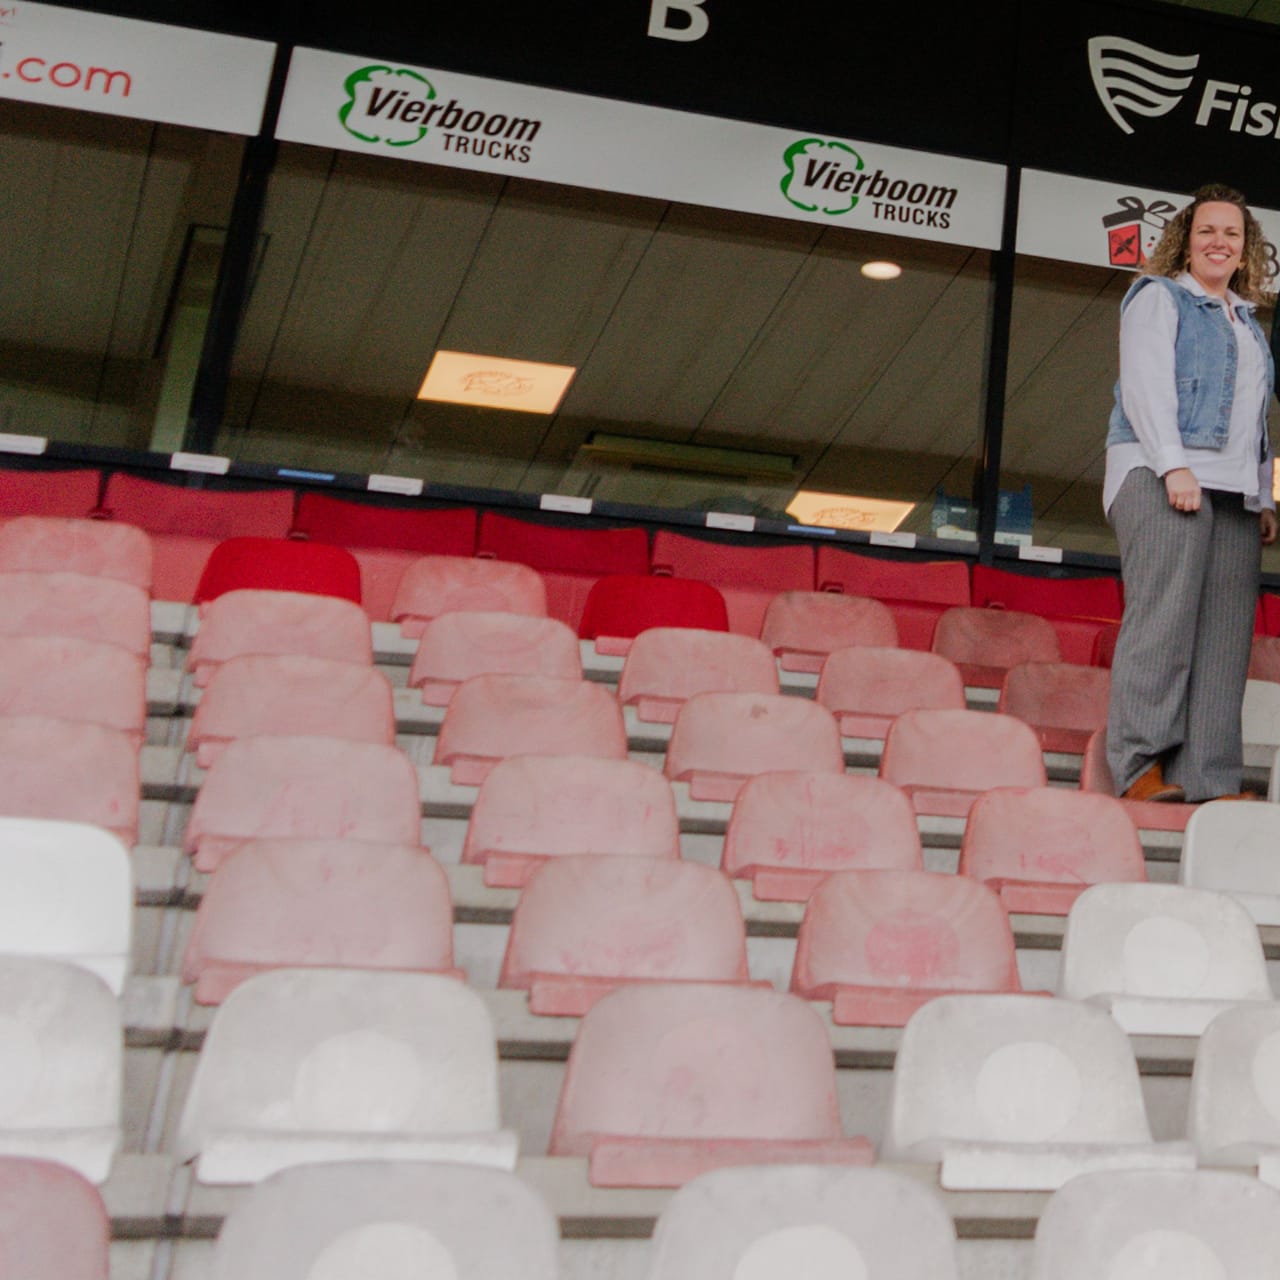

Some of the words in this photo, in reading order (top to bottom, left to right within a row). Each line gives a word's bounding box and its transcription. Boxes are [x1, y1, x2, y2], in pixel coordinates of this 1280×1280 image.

[365, 86, 542, 142] Vierboom
[442, 133, 532, 163] TRUCKS
[803, 158, 958, 209] Vierboom
[872, 201, 951, 229] TRUCKS
